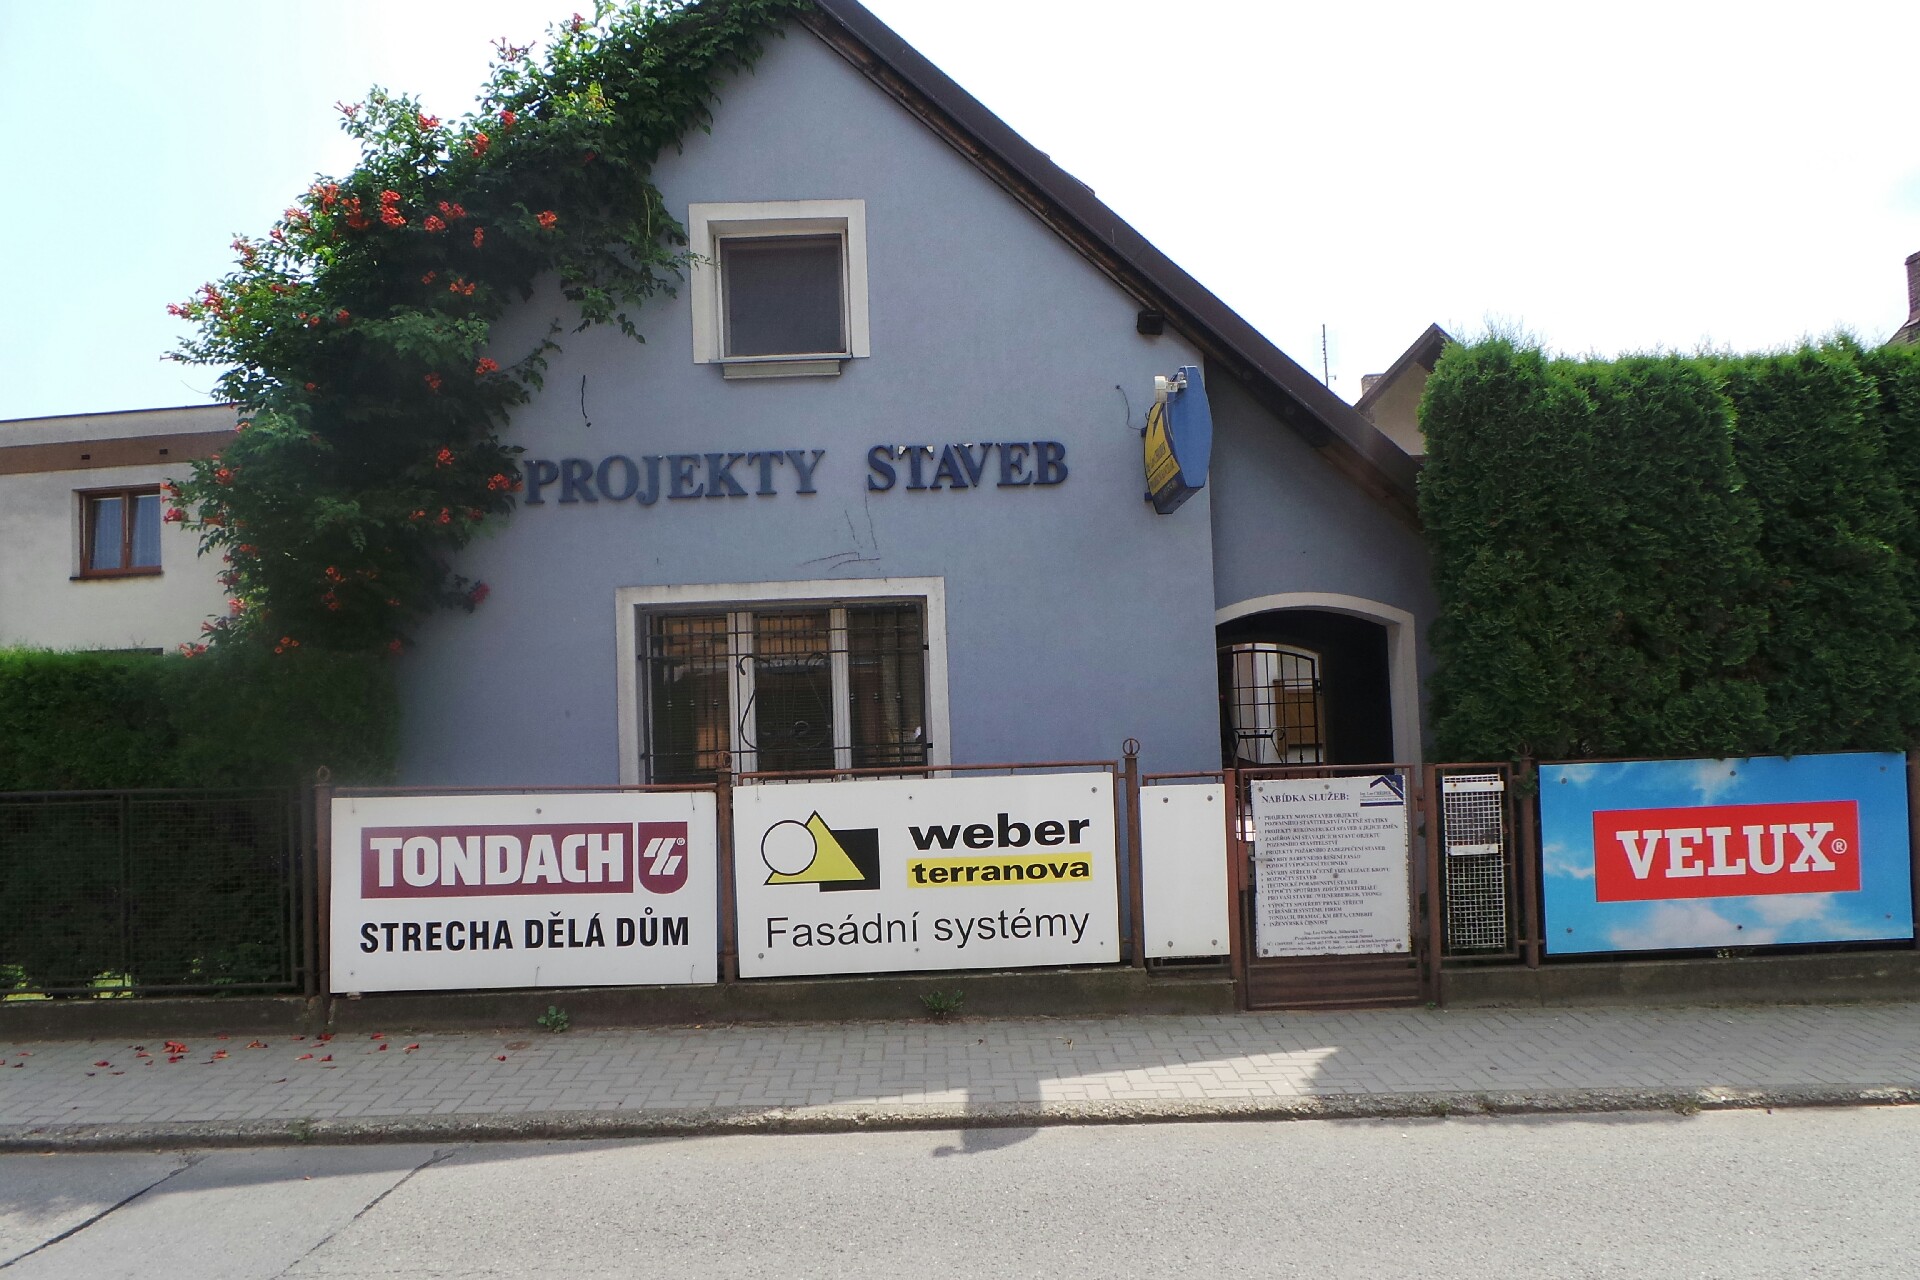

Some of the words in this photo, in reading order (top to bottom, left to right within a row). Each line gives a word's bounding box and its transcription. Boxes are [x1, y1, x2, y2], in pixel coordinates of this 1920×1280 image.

[523, 450, 825, 504] PROJEKTY
[866, 441, 1069, 491] STAVEB
[1262, 793, 1306, 803] NABÍDKA
[1309, 792, 1349, 802] SLUŽEB:
[908, 813, 1090, 850] weber
[370, 833, 623, 887] TONDACH
[911, 861, 1090, 884] terranova
[360, 919, 514, 953] STRECHA
[525, 910, 606, 949] DĚLÁ
[616, 906, 689, 947] DŮM
[766, 911, 920, 949] Fasádní
[934, 908, 1090, 949] systémy
